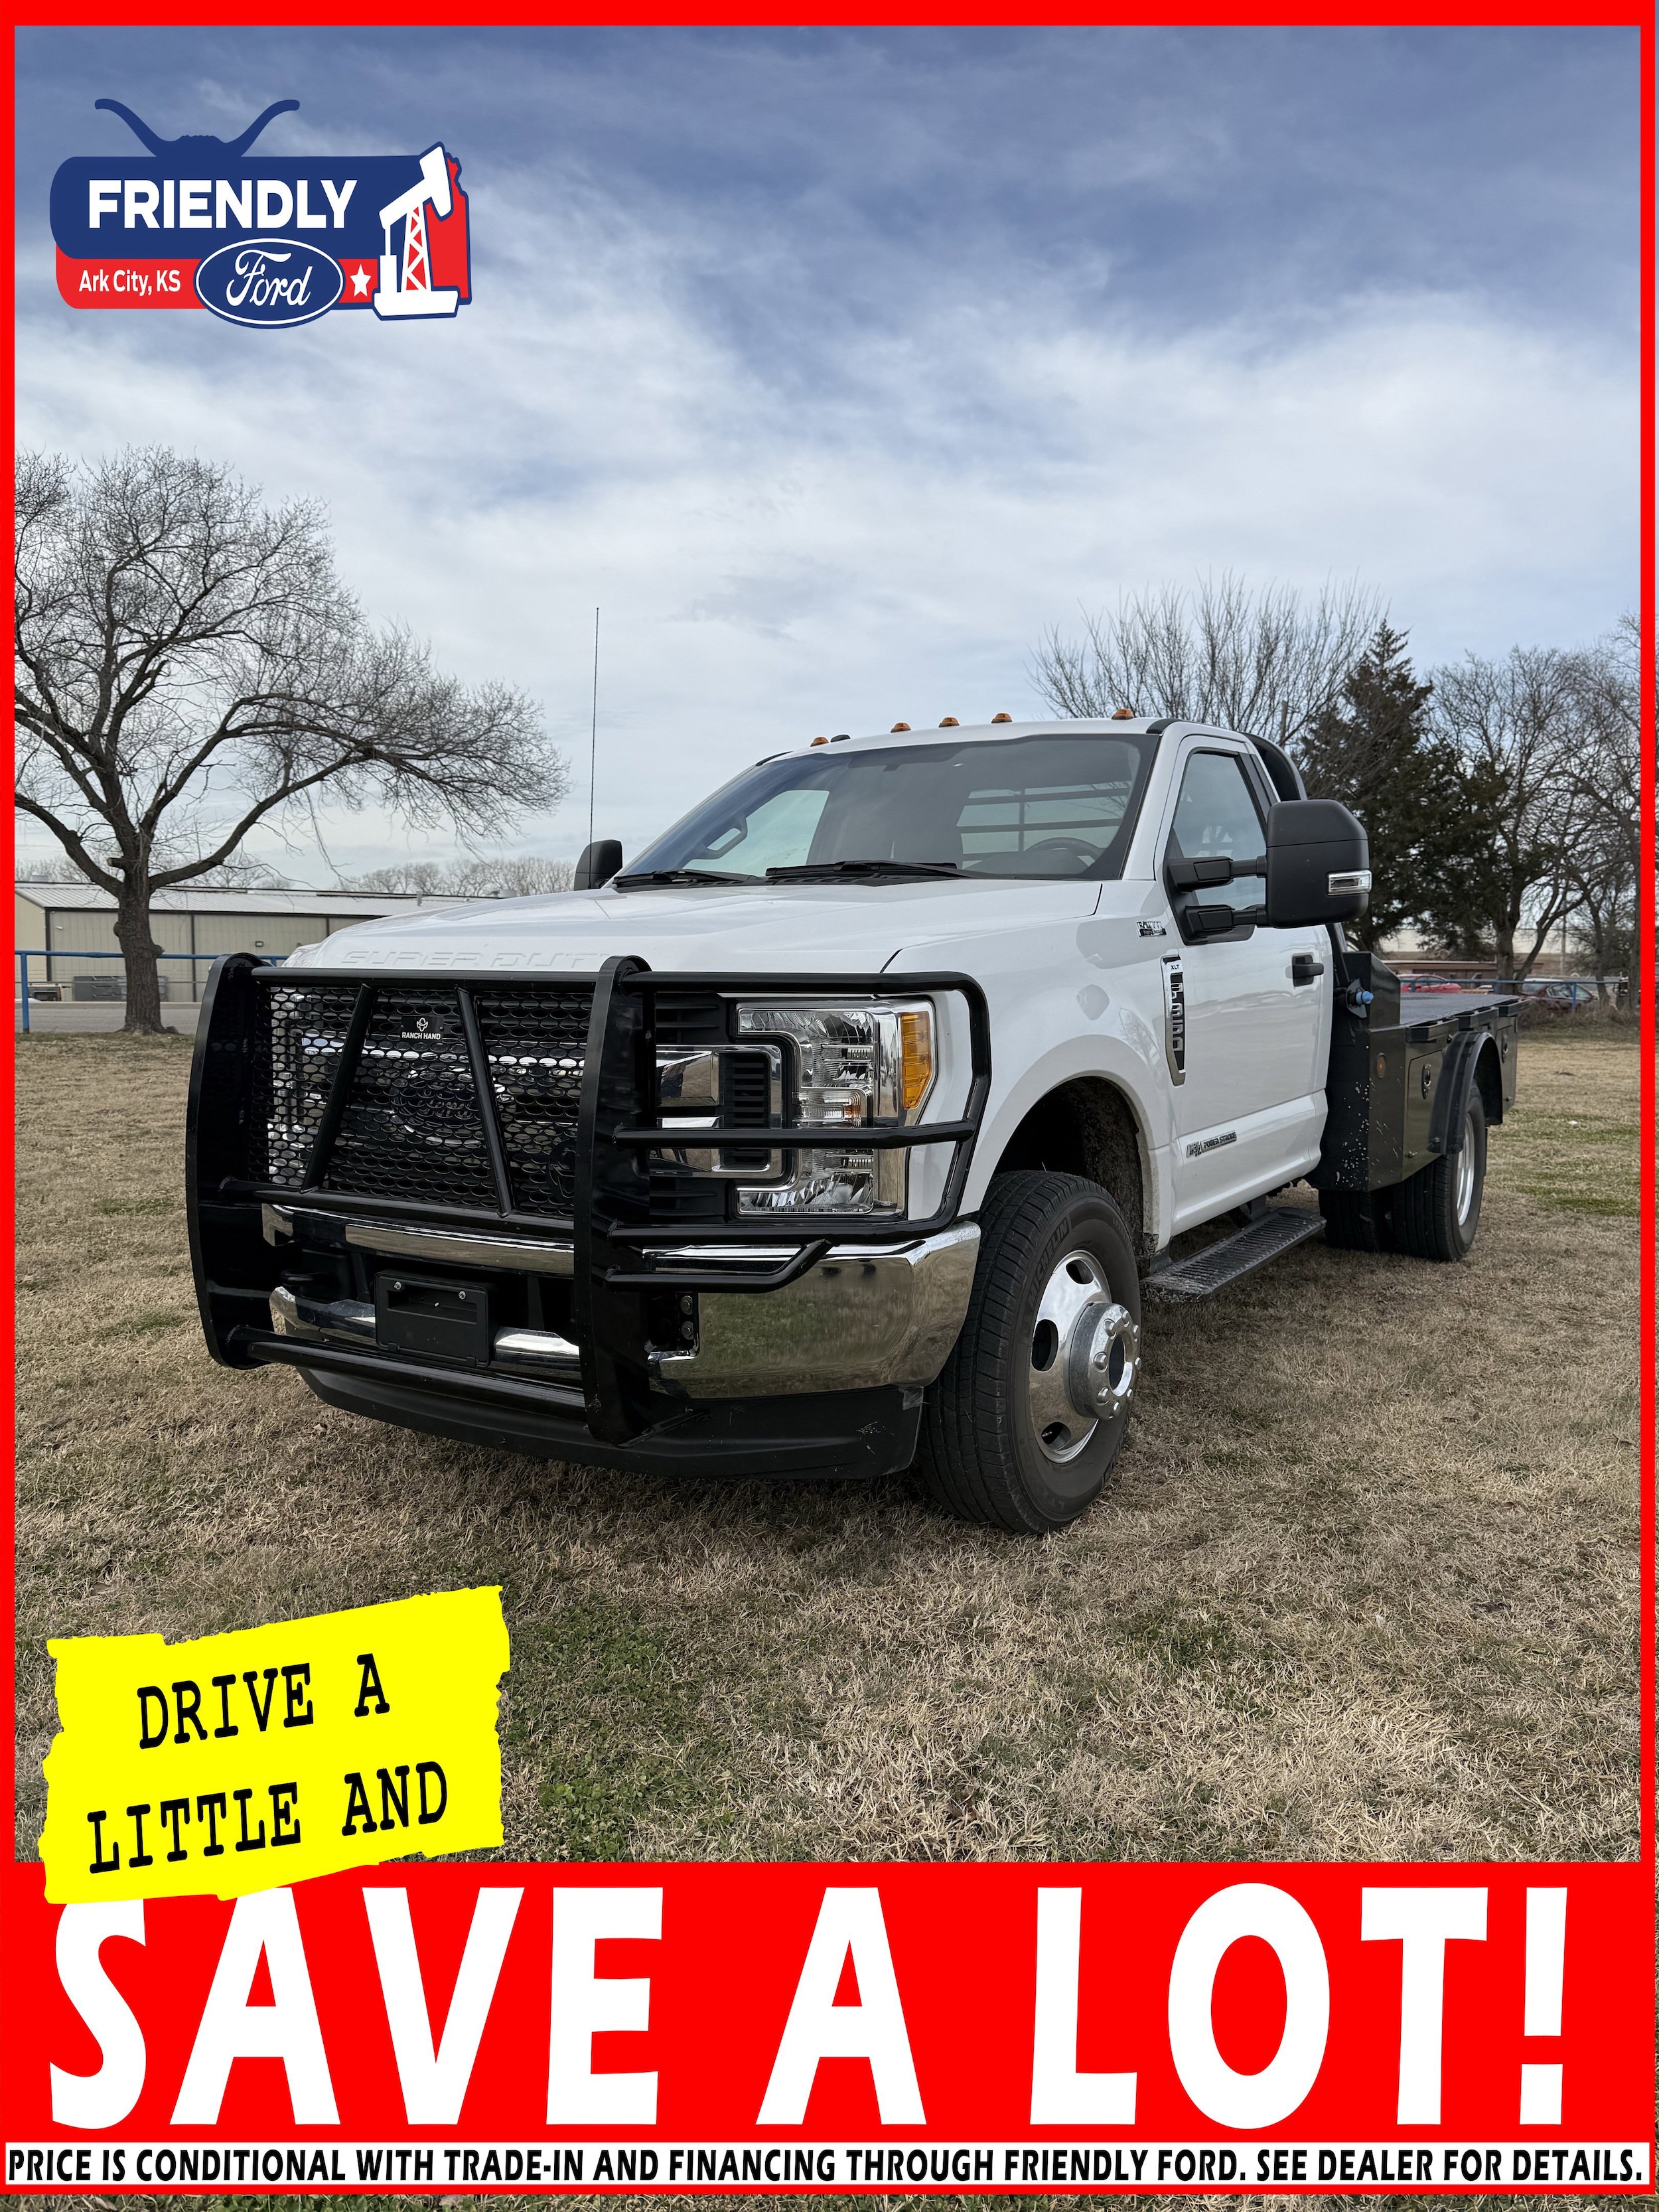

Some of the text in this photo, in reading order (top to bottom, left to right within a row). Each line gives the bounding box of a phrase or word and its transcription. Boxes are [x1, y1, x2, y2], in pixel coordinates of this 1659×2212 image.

[340, 950, 484, 968] SUPER
[401, 1031, 441, 1041] RANCH HAND
[1029, 1219, 1070, 1307] MICHELIN
